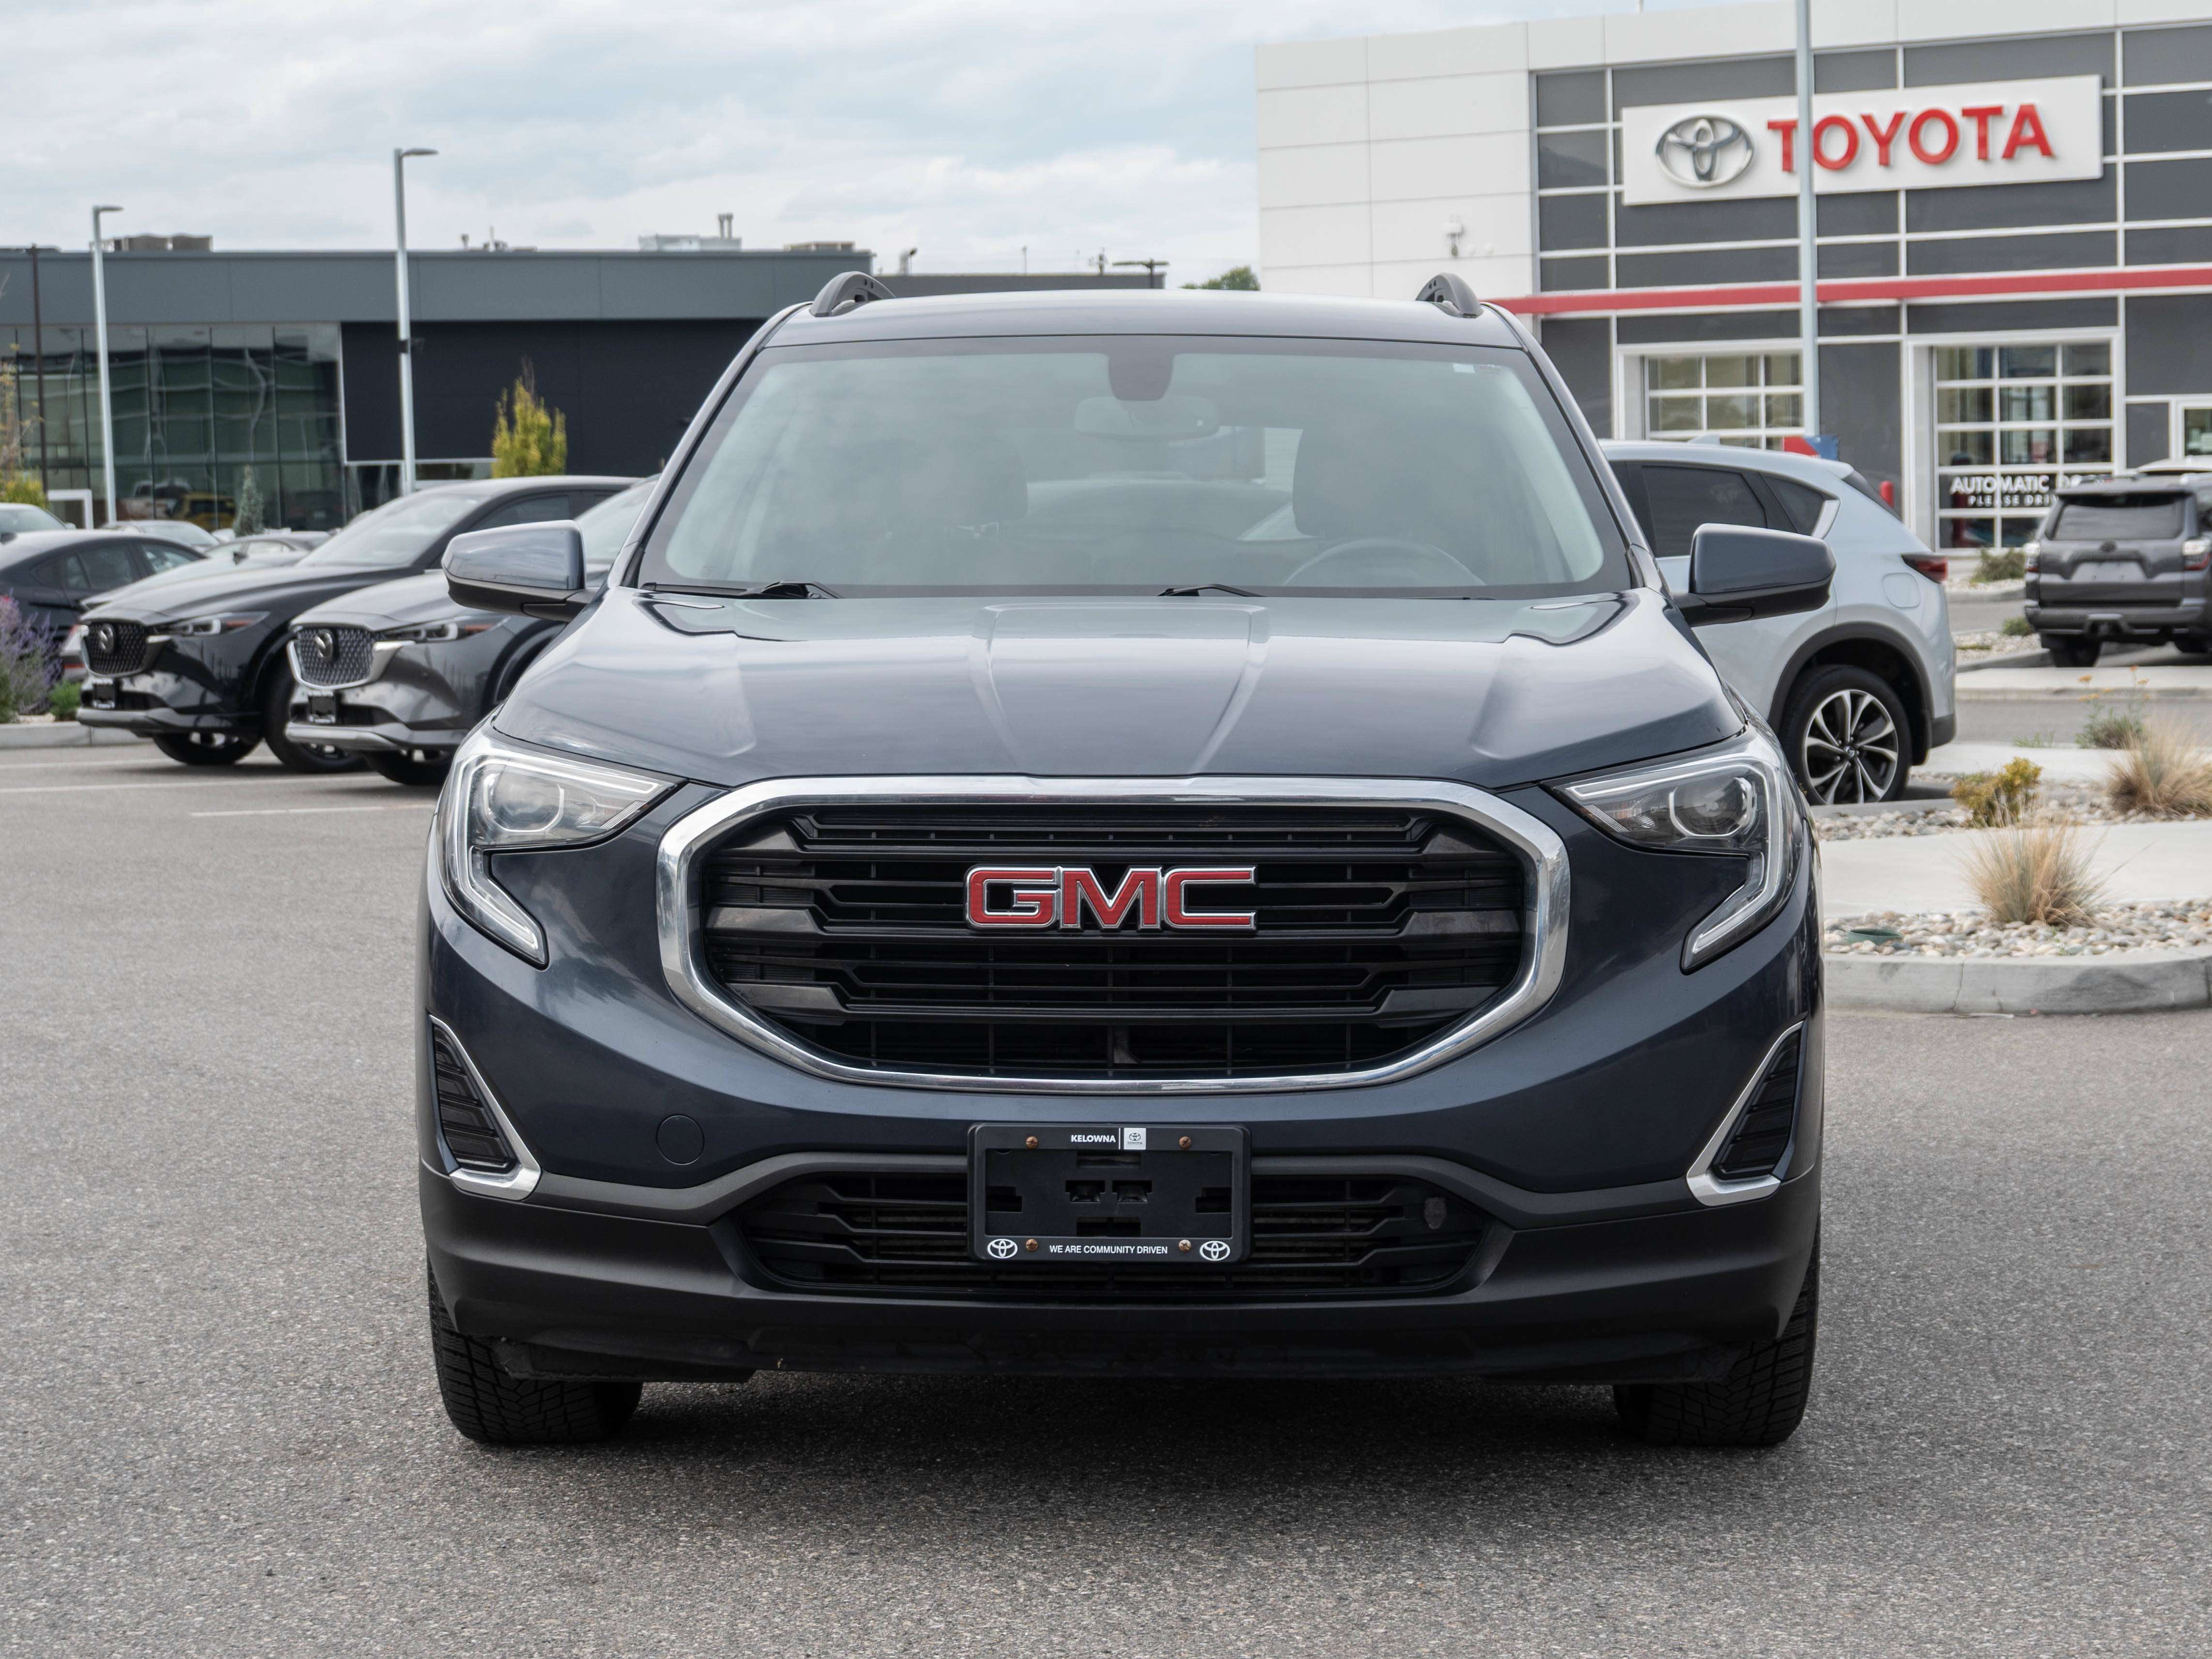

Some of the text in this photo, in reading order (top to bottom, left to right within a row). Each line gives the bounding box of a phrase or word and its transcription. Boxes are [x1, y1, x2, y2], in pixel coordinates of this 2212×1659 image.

[1767, 104, 2054, 173] TOYOTA
[1951, 475, 2049, 494] AUTOMATIC
[1968, 494, 2020, 506] PLESE
[964, 865, 1259, 932] GMC
[1065, 1245, 1082, 1253] ARE
[1083, 1246, 1135, 1254] COMMUNITY
[1137, 1246, 1168, 1254] DRIVEN
